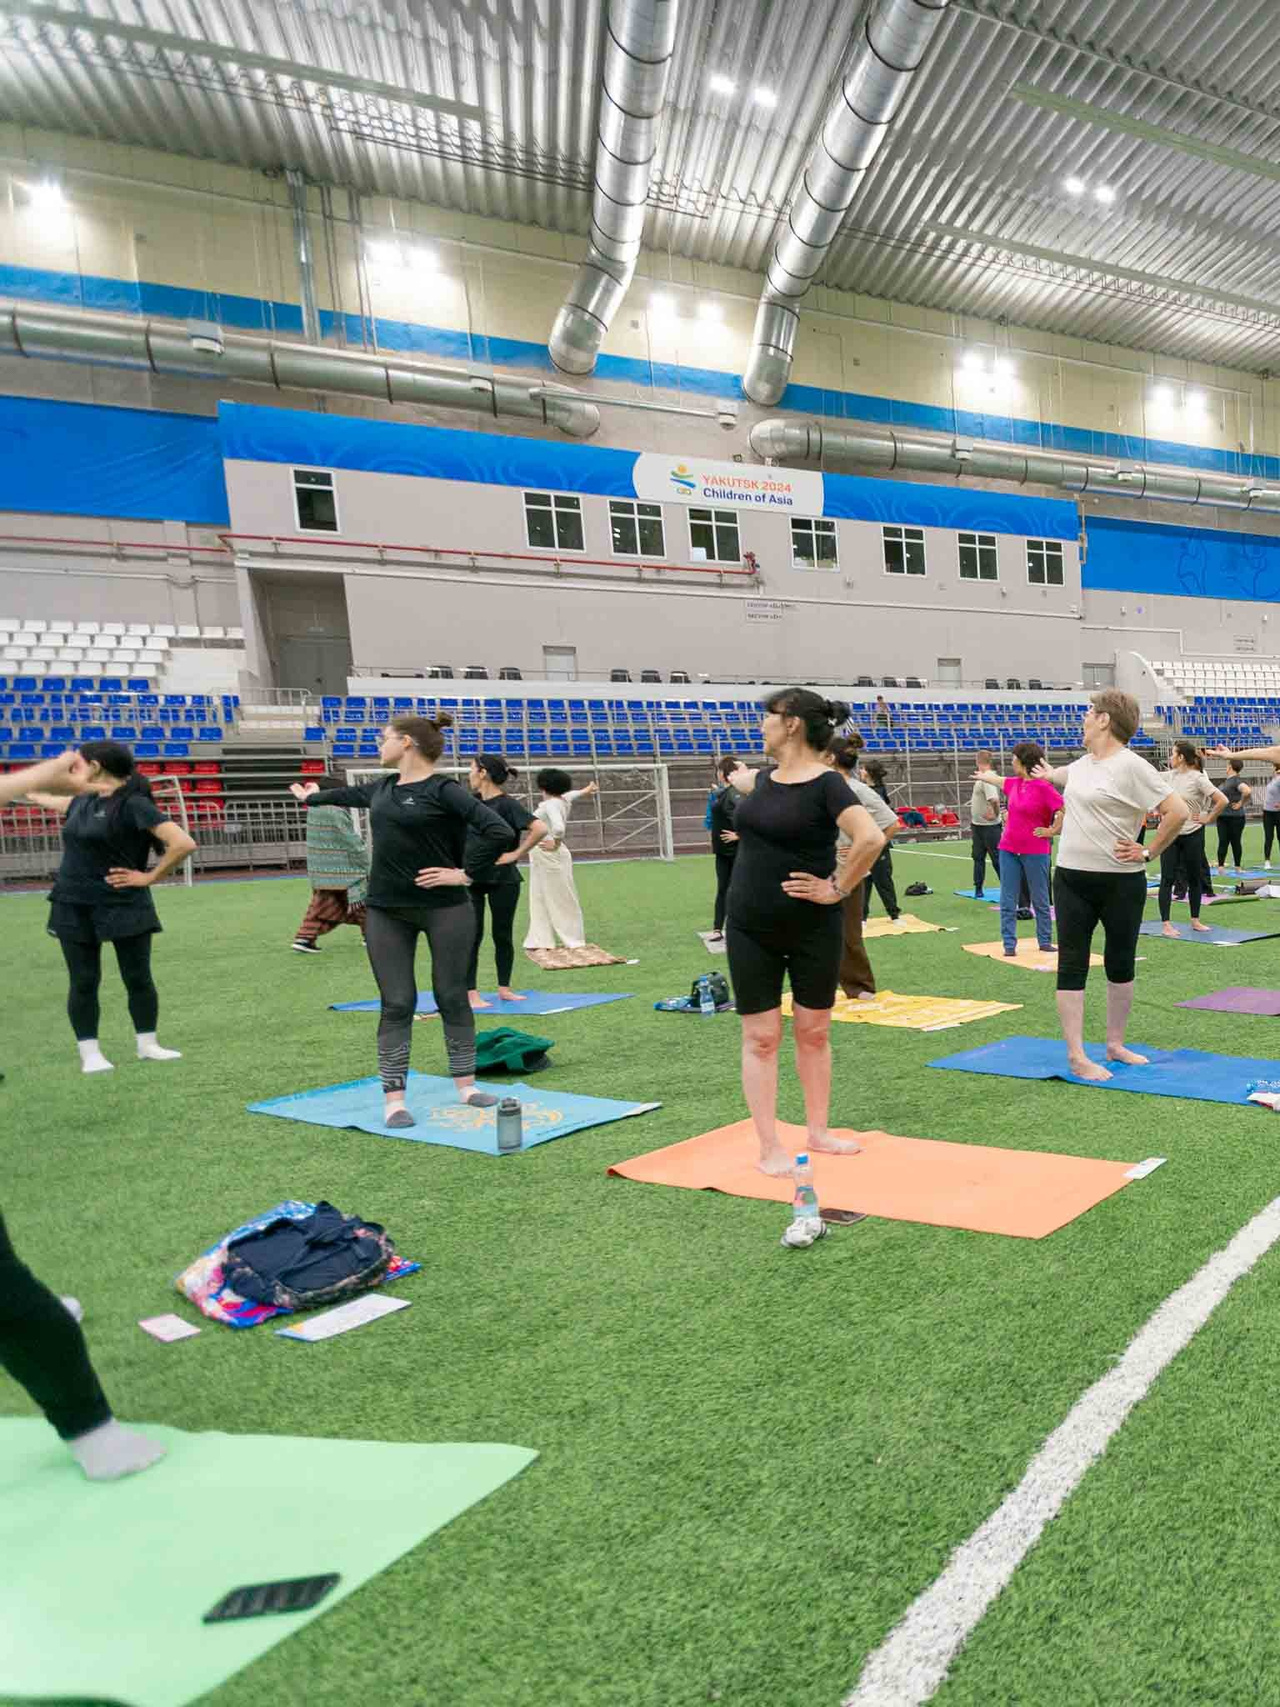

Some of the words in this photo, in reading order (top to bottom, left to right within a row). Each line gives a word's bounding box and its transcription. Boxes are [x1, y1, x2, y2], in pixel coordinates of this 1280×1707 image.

[701, 474, 759, 491] YAKUTSK
[762, 481, 792, 493] 2024
[703, 487, 752, 502] Children
[755, 493, 767, 503] of
[769, 494, 793, 506] Asia
